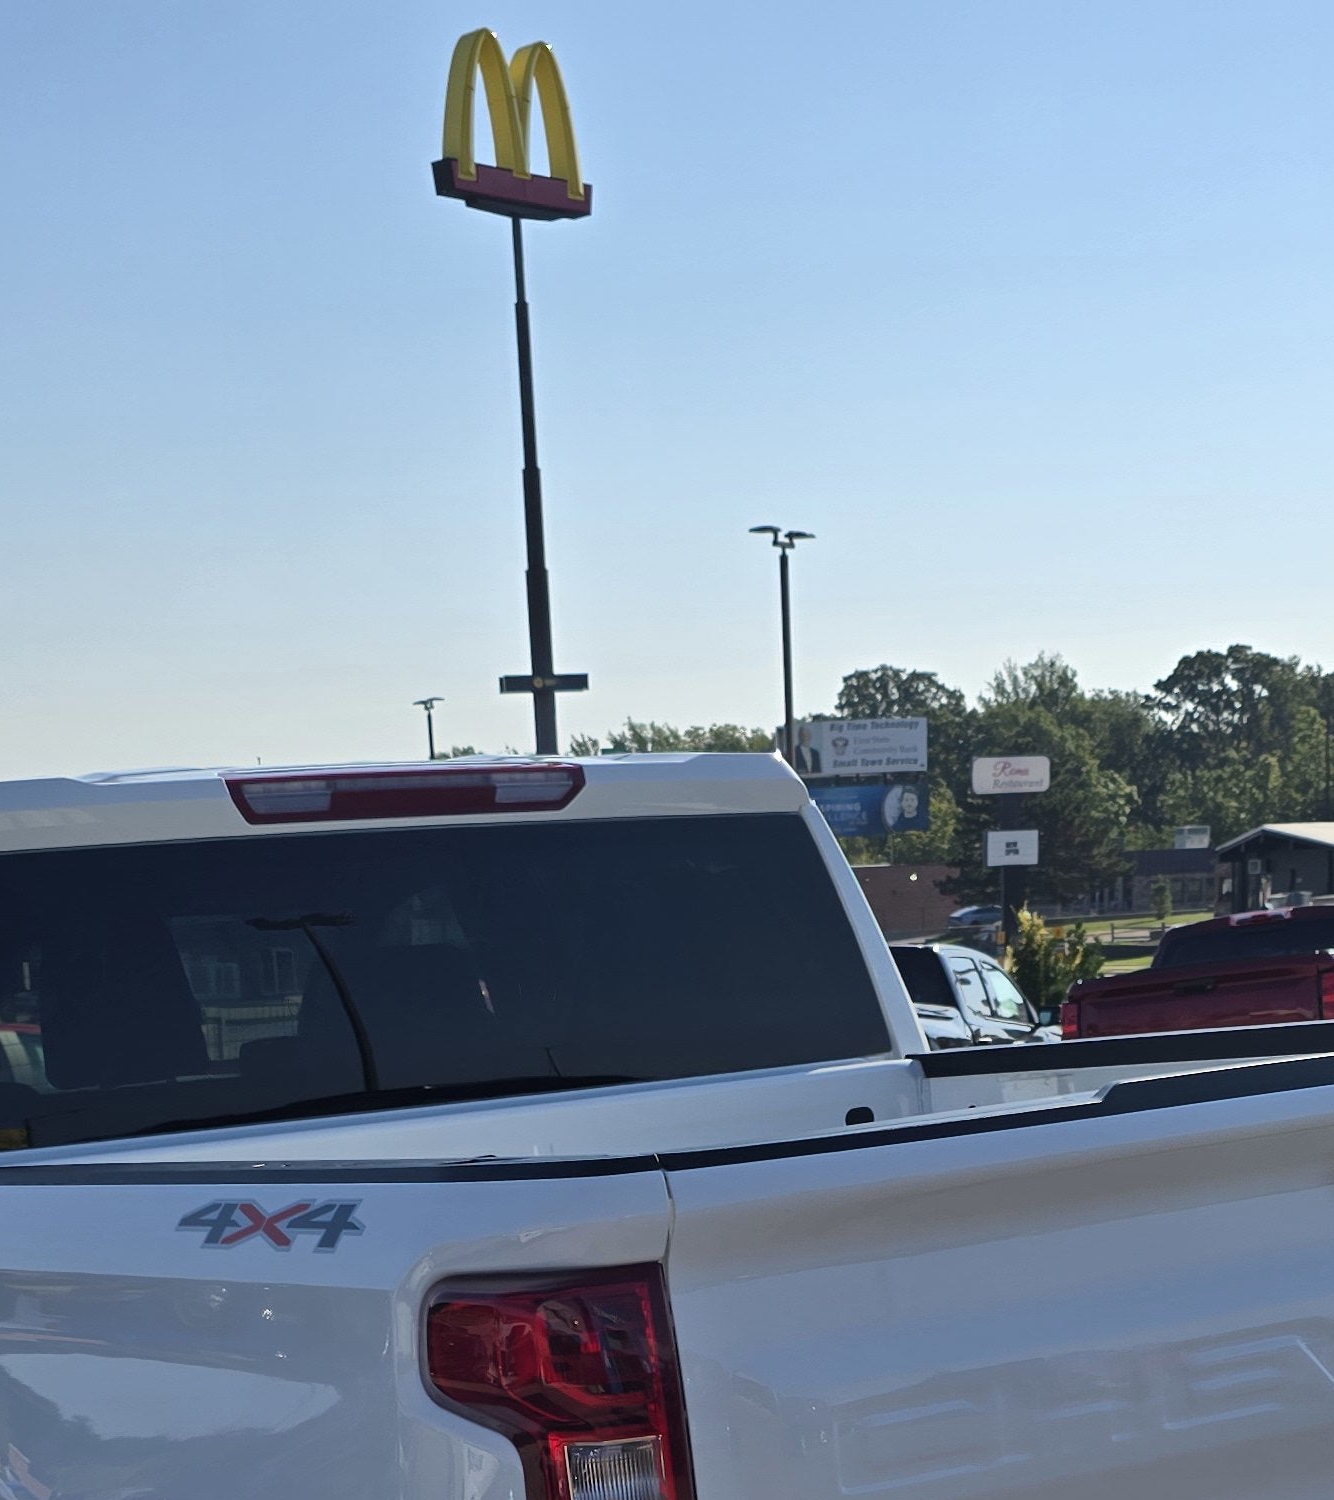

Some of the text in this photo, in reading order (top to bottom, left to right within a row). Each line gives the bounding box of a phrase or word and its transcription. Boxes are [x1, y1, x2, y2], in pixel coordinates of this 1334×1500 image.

[830, 720, 919, 733] Big Time Technology
[833, 759, 858, 768] Small
[861, 759, 883, 767] Town
[885, 757, 918, 766] Service
[992, 778, 1044, 789] Restaurant
